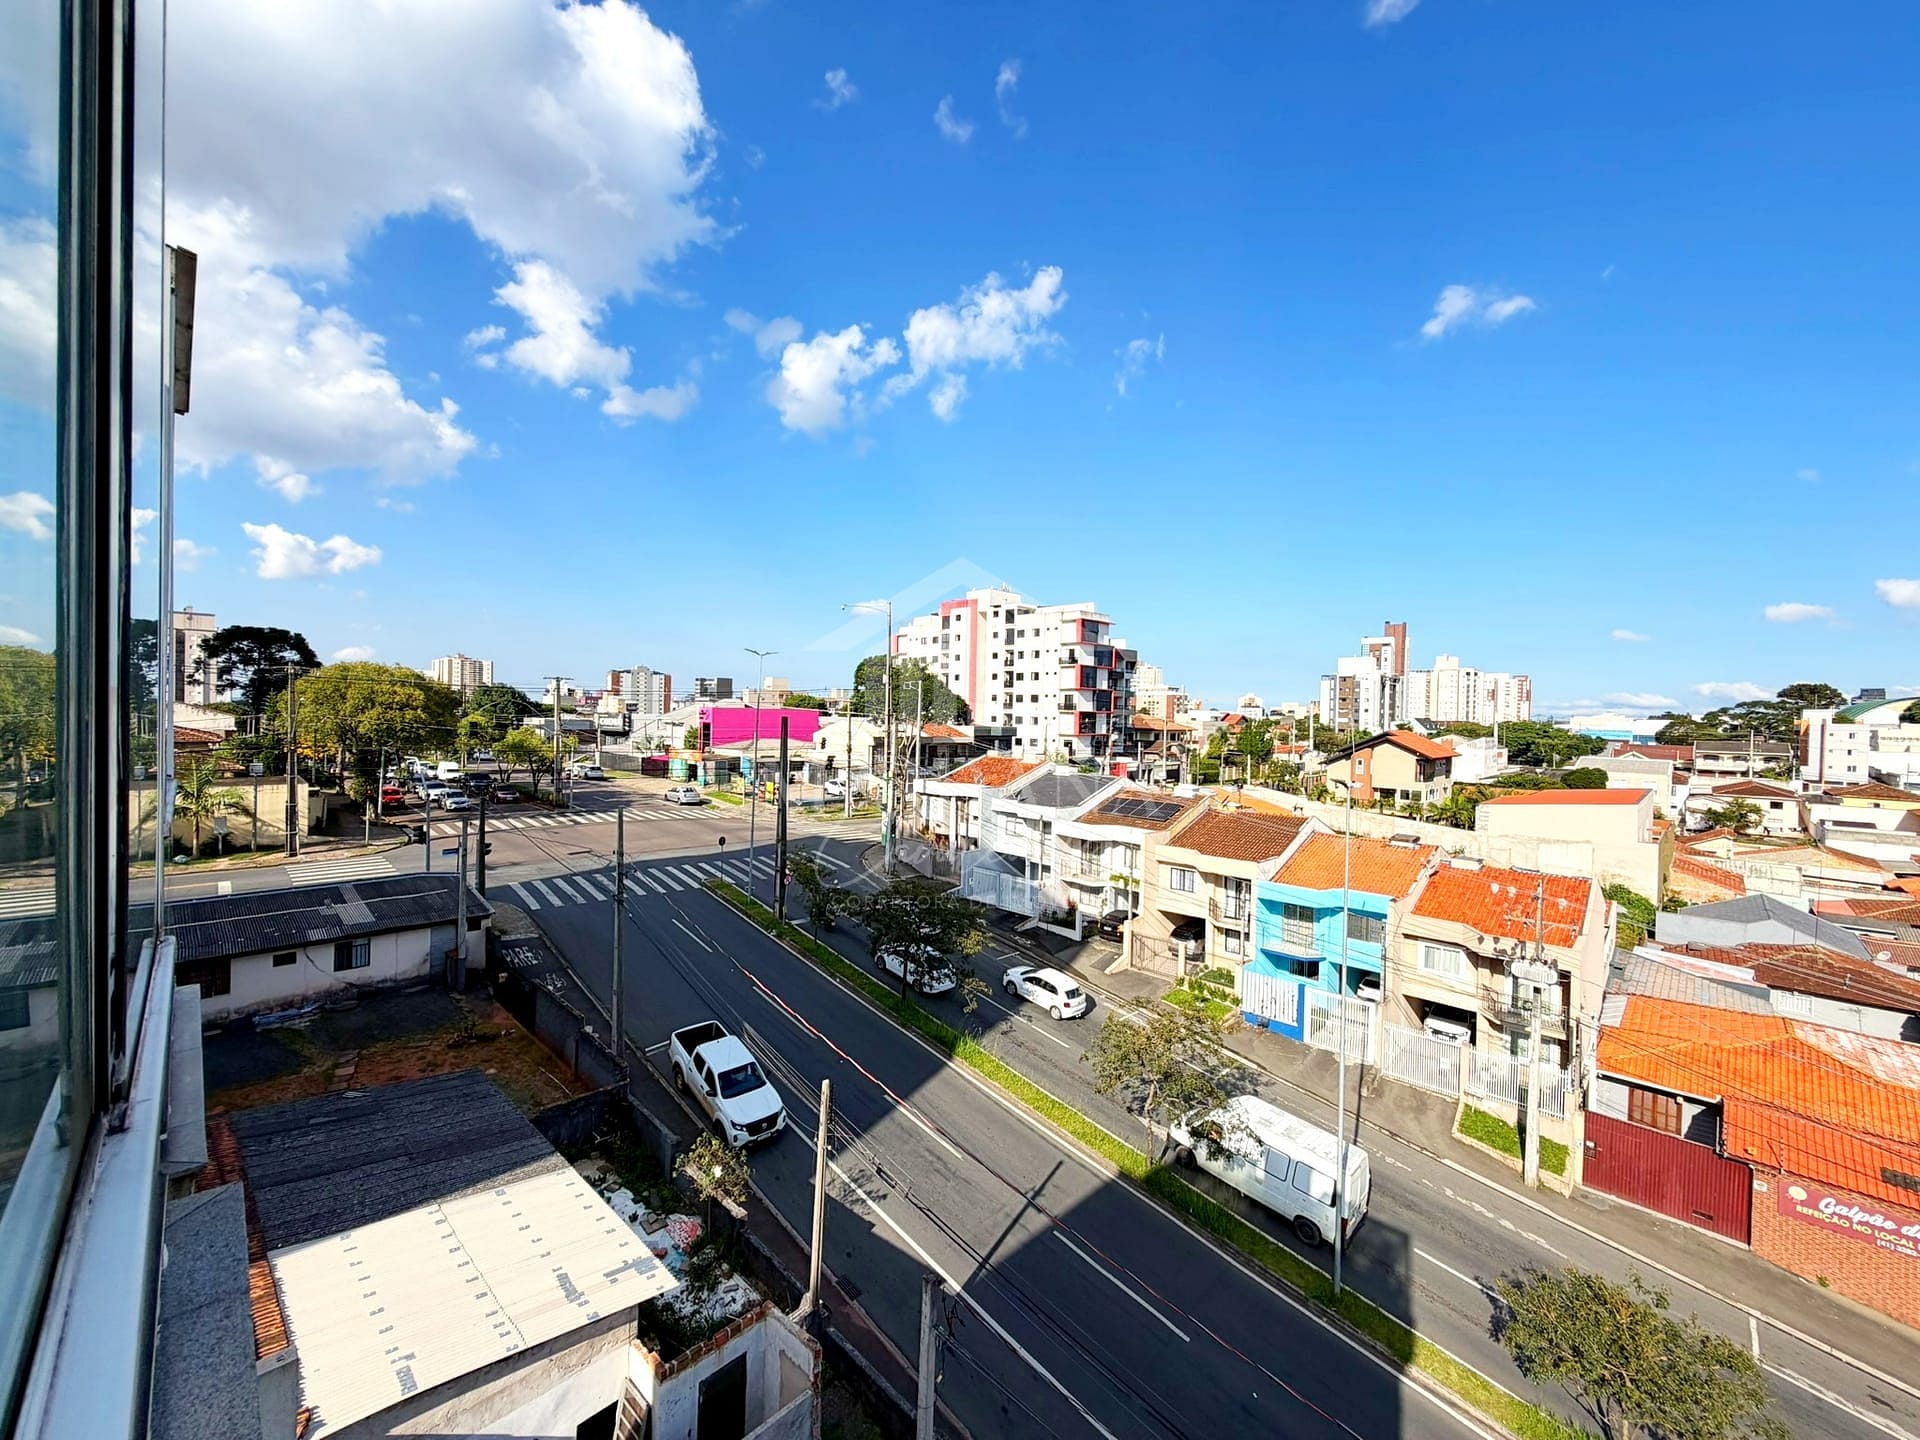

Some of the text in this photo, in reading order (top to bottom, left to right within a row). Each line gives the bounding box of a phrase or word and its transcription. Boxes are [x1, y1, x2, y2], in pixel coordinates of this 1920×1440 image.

[1796, 1205, 1850, 1228] REFEIÇÃO
[1852, 1223, 1872, 1235] NO
[1874, 1229, 1916, 1249] LOCAL
[1819, 1197, 1898, 1230] Galpão
